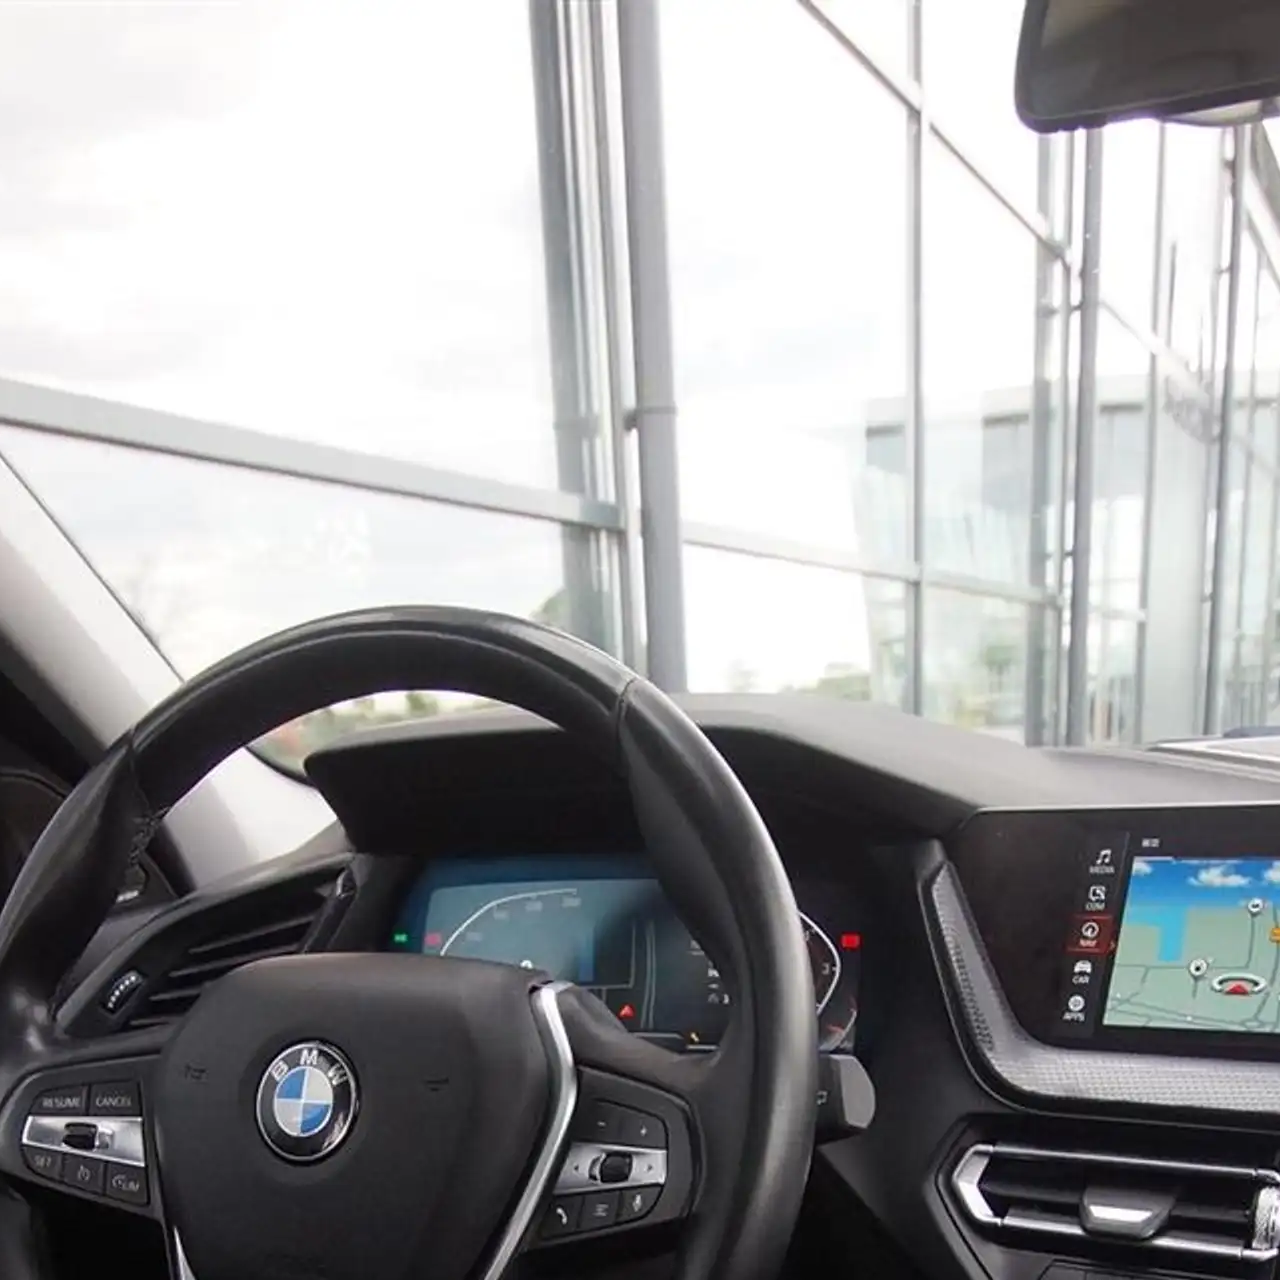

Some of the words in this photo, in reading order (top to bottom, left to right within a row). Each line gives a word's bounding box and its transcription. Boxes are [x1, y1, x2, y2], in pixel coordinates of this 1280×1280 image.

[270, 1049, 348, 1086] BMW
[42, 1096, 81, 1109] RESUME
[95, 1096, 132, 1108] CANCEL
